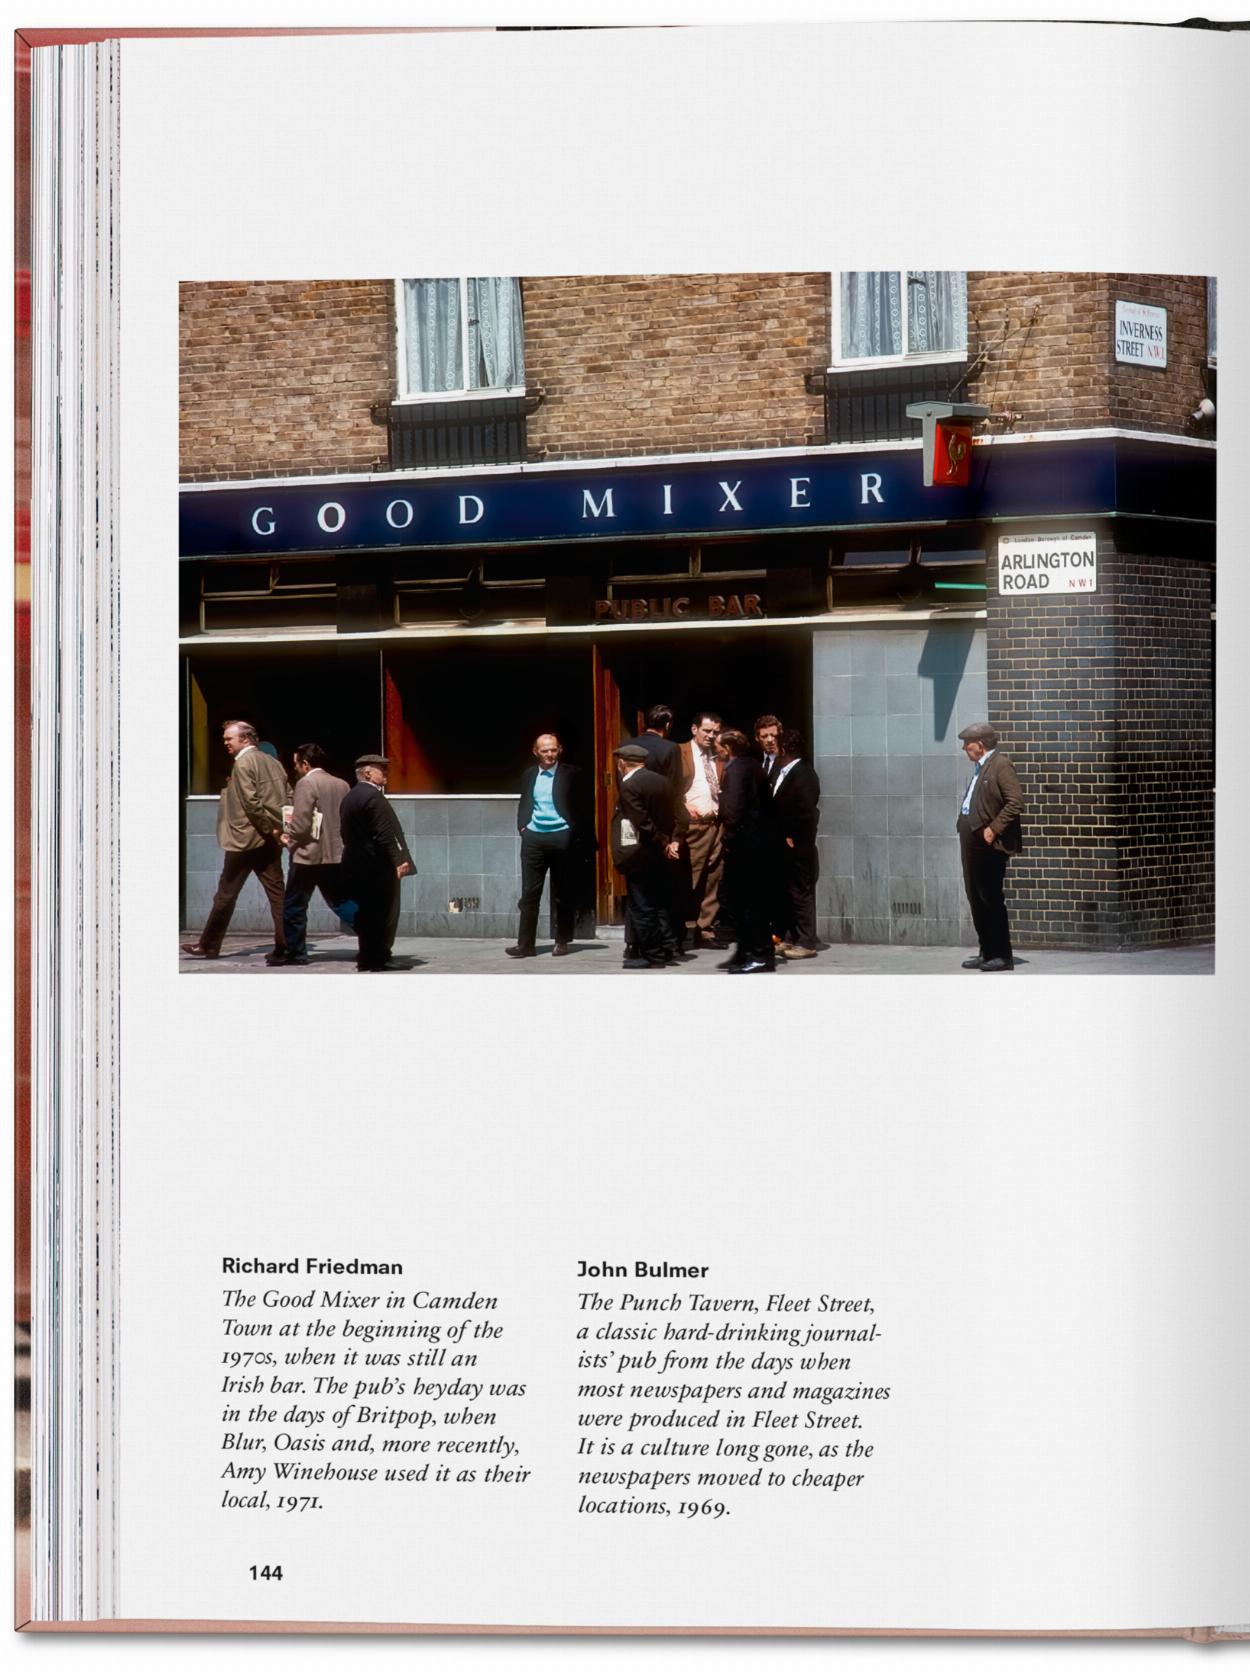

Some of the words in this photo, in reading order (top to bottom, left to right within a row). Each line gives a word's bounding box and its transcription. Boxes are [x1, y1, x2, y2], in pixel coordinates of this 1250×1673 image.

[1119, 320, 1163, 341] INVERNESS
[1117, 339, 1144, 357] STREET
[251, 494, 485, 536] GOOD
[581, 472, 885, 518] MIXER
[1001, 551, 1095, 570] ARLINGTON
[1003, 573, 1050, 590] ROAD
[595, 597, 690, 620] PUBLIC
[708, 594, 763, 617] BAR
[223, 1257, 299, 1274] Richard
[307, 1258, 403, 1275] Friedman
[577, 1261, 627, 1277] John
[635, 1261, 709, 1278] Bulmer
[223, 1289, 256, 1307] The
[263, 1290, 316, 1308] Good
[320, 1290, 380, 1308] Mixer
[386, 1291, 405, 1309] in
[413, 1291, 498, 1309] Camden
[579, 1292, 614, 1311] The
[620, 1293, 682, 1311] Punch
[689, 1294, 759, 1314] Tavern,
[766, 1294, 811, 1312] Fleet
[818, 1294, 874, 1315] Street,
[223, 1319, 272, 1336] Town
[279, 1322, 300, 1336] at
[306, 1319, 336, 1337] the
[342, 1319, 442, 1343] beginning
[447, 1319, 472, 1344] of
[474, 1320, 503, 1339] the
[576, 1327, 589, 1339] a
[596, 1322, 657, 1340] classic
[664, 1322, 800, 1347] hard-drinking
[800, 1323, 882, 1347] journal-
[221, 1352, 277, 1368] 1970s,
[285, 1347, 336, 1365] when
[344, 1348, 358, 1365] it
[365, 1353, 401, 1366] was
[407, 1348, 447, 1366] still
[451, 1354, 477, 1367] an
[616, 1350, 657, 1373] pub
[657, 1350, 708, 1374] from
[716, 1351, 745, 1369] the
[751, 1351, 794, 1375] days
[800, 1352, 851, 1370] when
[221, 1375, 264, 1393] Irish
[270, 1375, 306, 1394] bar.
[314, 1376, 348, 1394] The
[413, 1377, 483, 1401] heyday
[489, 1384, 527, 1396] was
[578, 1383, 624, 1397] most
[630, 1384, 742, 1403] newspapers
[748, 1381, 787, 1399] and
[793, 1381, 891, 1405] magazines
[222, 1404, 240, 1422] in
[248, 1404, 277, 1422] the
[283, 1404, 325, 1428] days
[332, 1404, 356, 1429] of
[356, 1406, 436, 1429] Britpop,
[444, 1406, 496, 1425] when
[578, 1414, 623, 1427] were
[628, 1409, 720, 1432] produced
[726, 1410, 745, 1428] in
[752, 1410, 799, 1428] Fleet
[804, 1411, 862, 1429] Street.
[221, 1432, 266, 1453] Blur,
[274, 1433, 325, 1451] Oasis
[331, 1434, 374, 1454] and,
[382, 1440, 431, 1453] more
[437, 1435, 519, 1459] recently,
[578, 1438, 595, 1455] It
[601, 1437, 615, 1455] is
[621, 1443, 633, 1455] a
[640, 1438, 710, 1456] culture
[716, 1438, 760, 1462] long
[763, 1445, 813, 1462] gone,
[819, 1445, 839, 1457] as
[845, 1439, 874, 1458] the
[221, 1462, 266, 1485] Amy
[274, 1462, 378, 1481] Winehouse
[385, 1463, 430, 1481] used
[436, 1464, 451, 1482] it
[456, 1470, 477, 1482] as
[484, 1464, 531, 1483] their
[578, 1470, 691, 1490] newspapers
[697, 1468, 763, 1486] moved
[768, 1472, 785, 1486] to
[792, 1468, 864, 1492] cheaper
[221, 1490, 270, 1510] local,
[277, 1496, 323, 1512] 1971.
[578, 1495, 670, 1516] locations,
[678, 1499, 730, 1519] 1969.
[248, 1565, 284, 1581] 144
